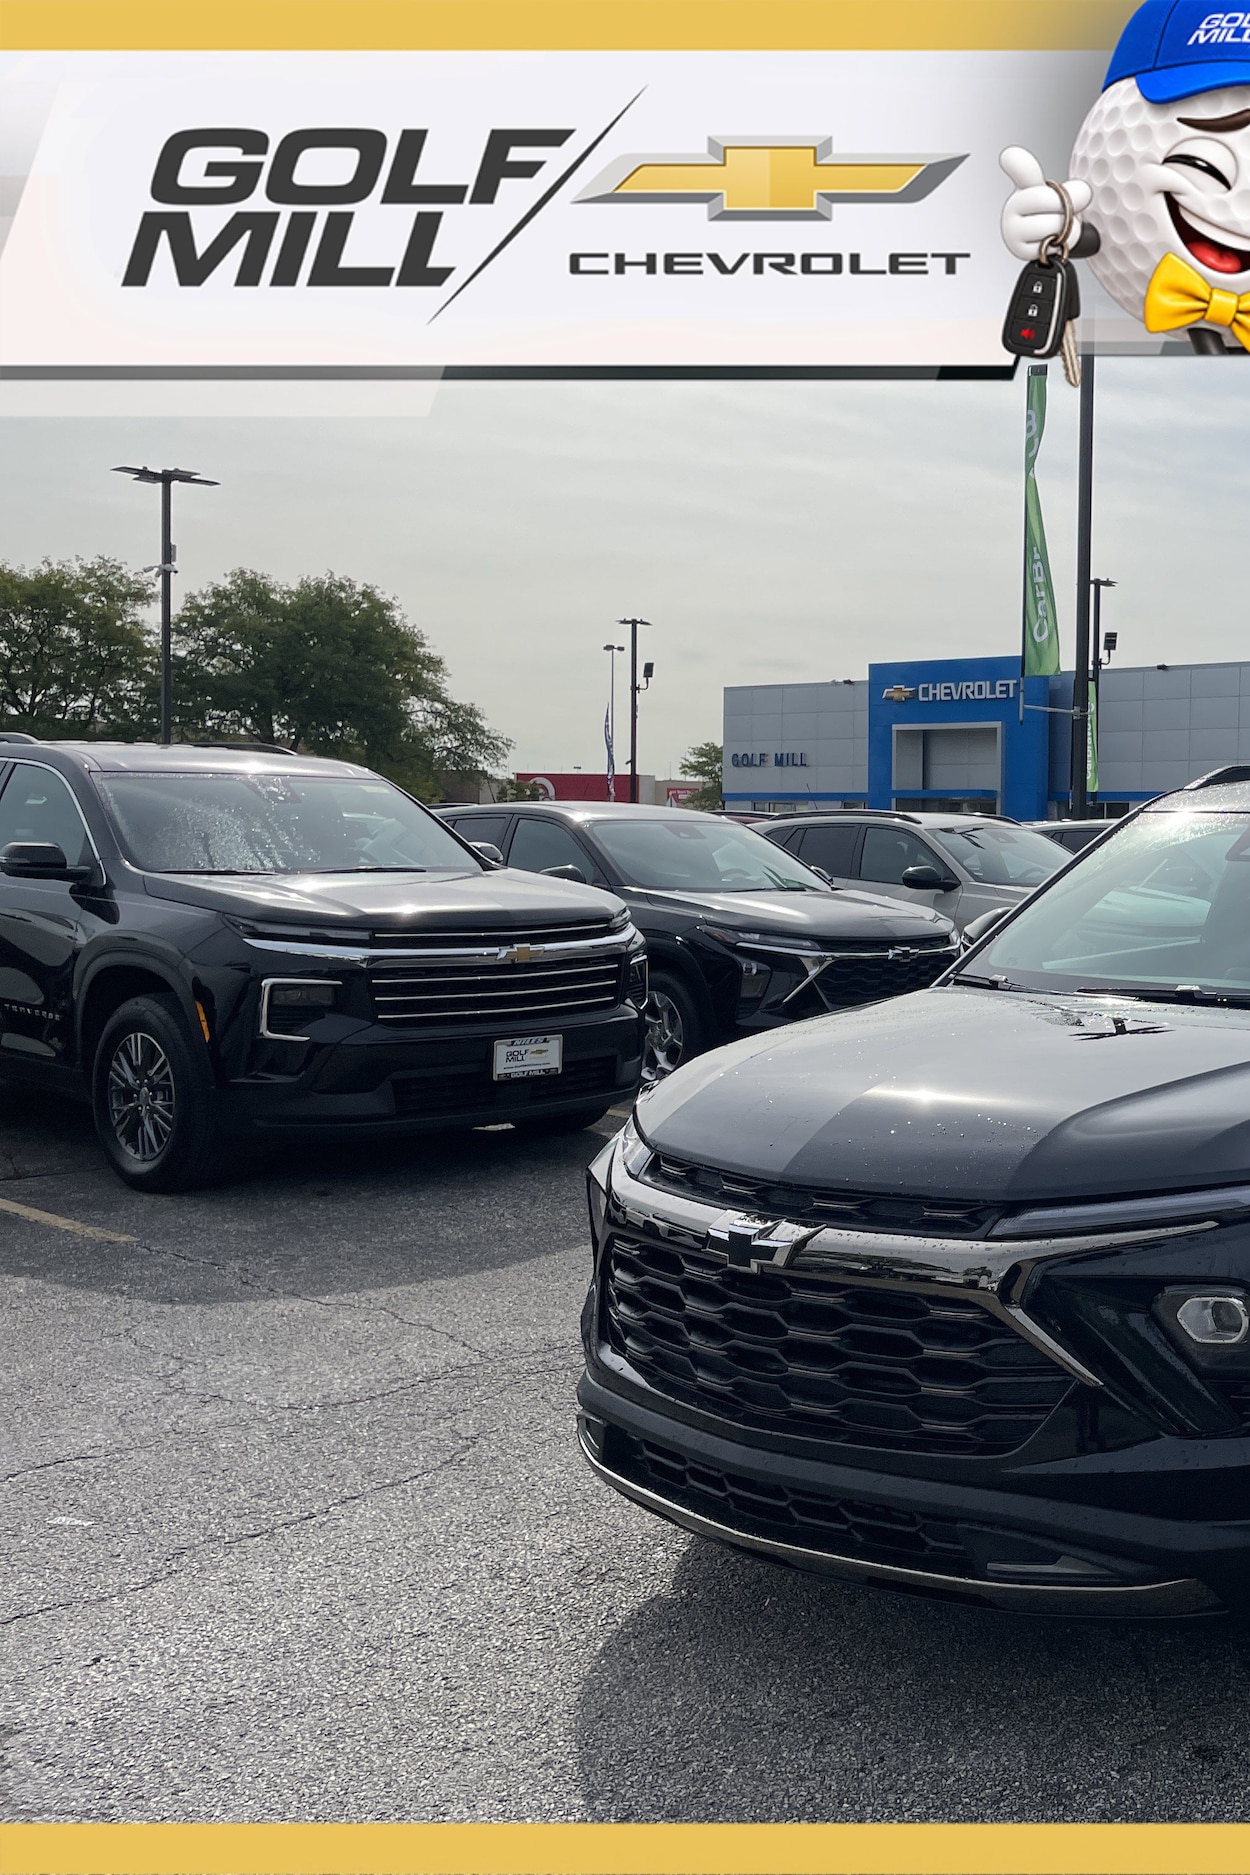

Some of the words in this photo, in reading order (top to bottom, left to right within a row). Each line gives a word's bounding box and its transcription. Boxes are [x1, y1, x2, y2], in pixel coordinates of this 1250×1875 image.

[918, 679, 1018, 702] CHEVROLET
[731, 752, 769, 768] GOLF
[774, 751, 809, 768] MILL
[505, 1049, 530, 1057] GOLF
[505, 1055, 526, 1064] MILL
